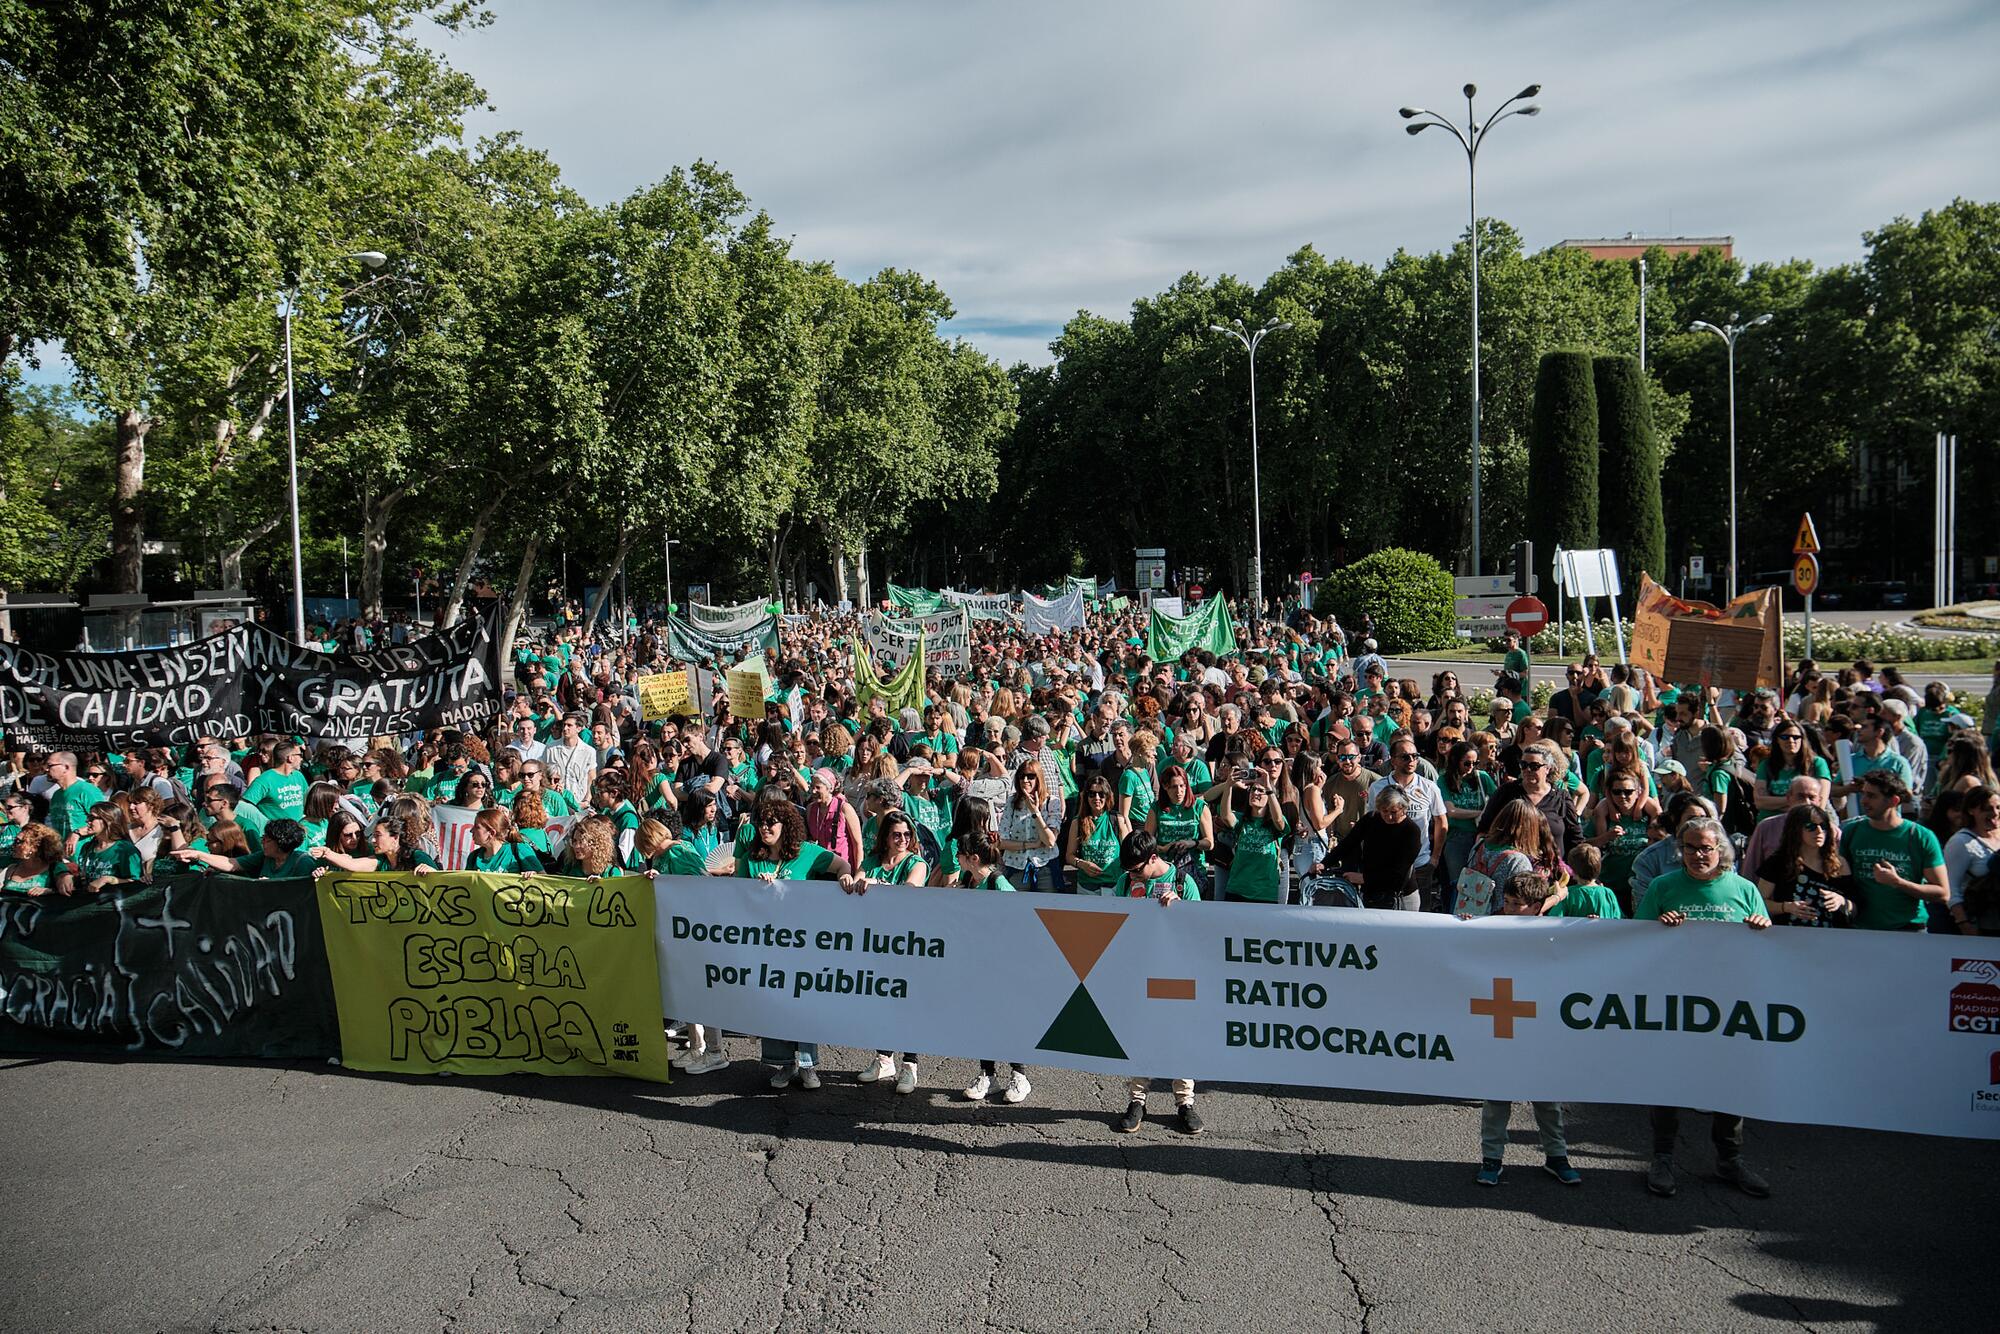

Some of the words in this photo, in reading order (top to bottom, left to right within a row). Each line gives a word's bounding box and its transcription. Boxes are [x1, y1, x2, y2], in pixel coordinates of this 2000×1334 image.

[1799, 568, 1812, 581] 30
[880, 631, 905, 649] SER
[65, 656, 140, 689] UNA
[0, 685, 46, 725] DE
[59, 684, 211, 729] CALIDAD
[255, 672, 275, 705] Y
[297, 657, 493, 716] GRATUITA
[169, 713, 252, 746] CIUDAD
[259, 708, 277, 732] DE
[281, 710, 311, 735] LOS
[441, 697, 501, 726] MADRID
[493, 885, 569, 927] CON
[587, 887, 637, 927] LA
[672, 916, 806, 948] Docentes
[815, 928, 853, 952] en
[863, 928, 945, 958] lucha
[1224, 937, 1379, 970] LECTIVAS
[403, 934, 586, 989] ESCUELA
[705, 963, 751, 987] por
[759, 962, 785, 989] la
[793, 967, 908, 999] pública
[1225, 978, 1328, 1009] RATIO
[1954, 1005, 1999, 1013] MADRID
[388, 995, 607, 1065] PÚBLICA
[1559, 992, 1807, 1043] CALIDAD
[1953, 1015, 1999, 1032] CGT
[1226, 1020, 1455, 1062] BUROCRACIA
